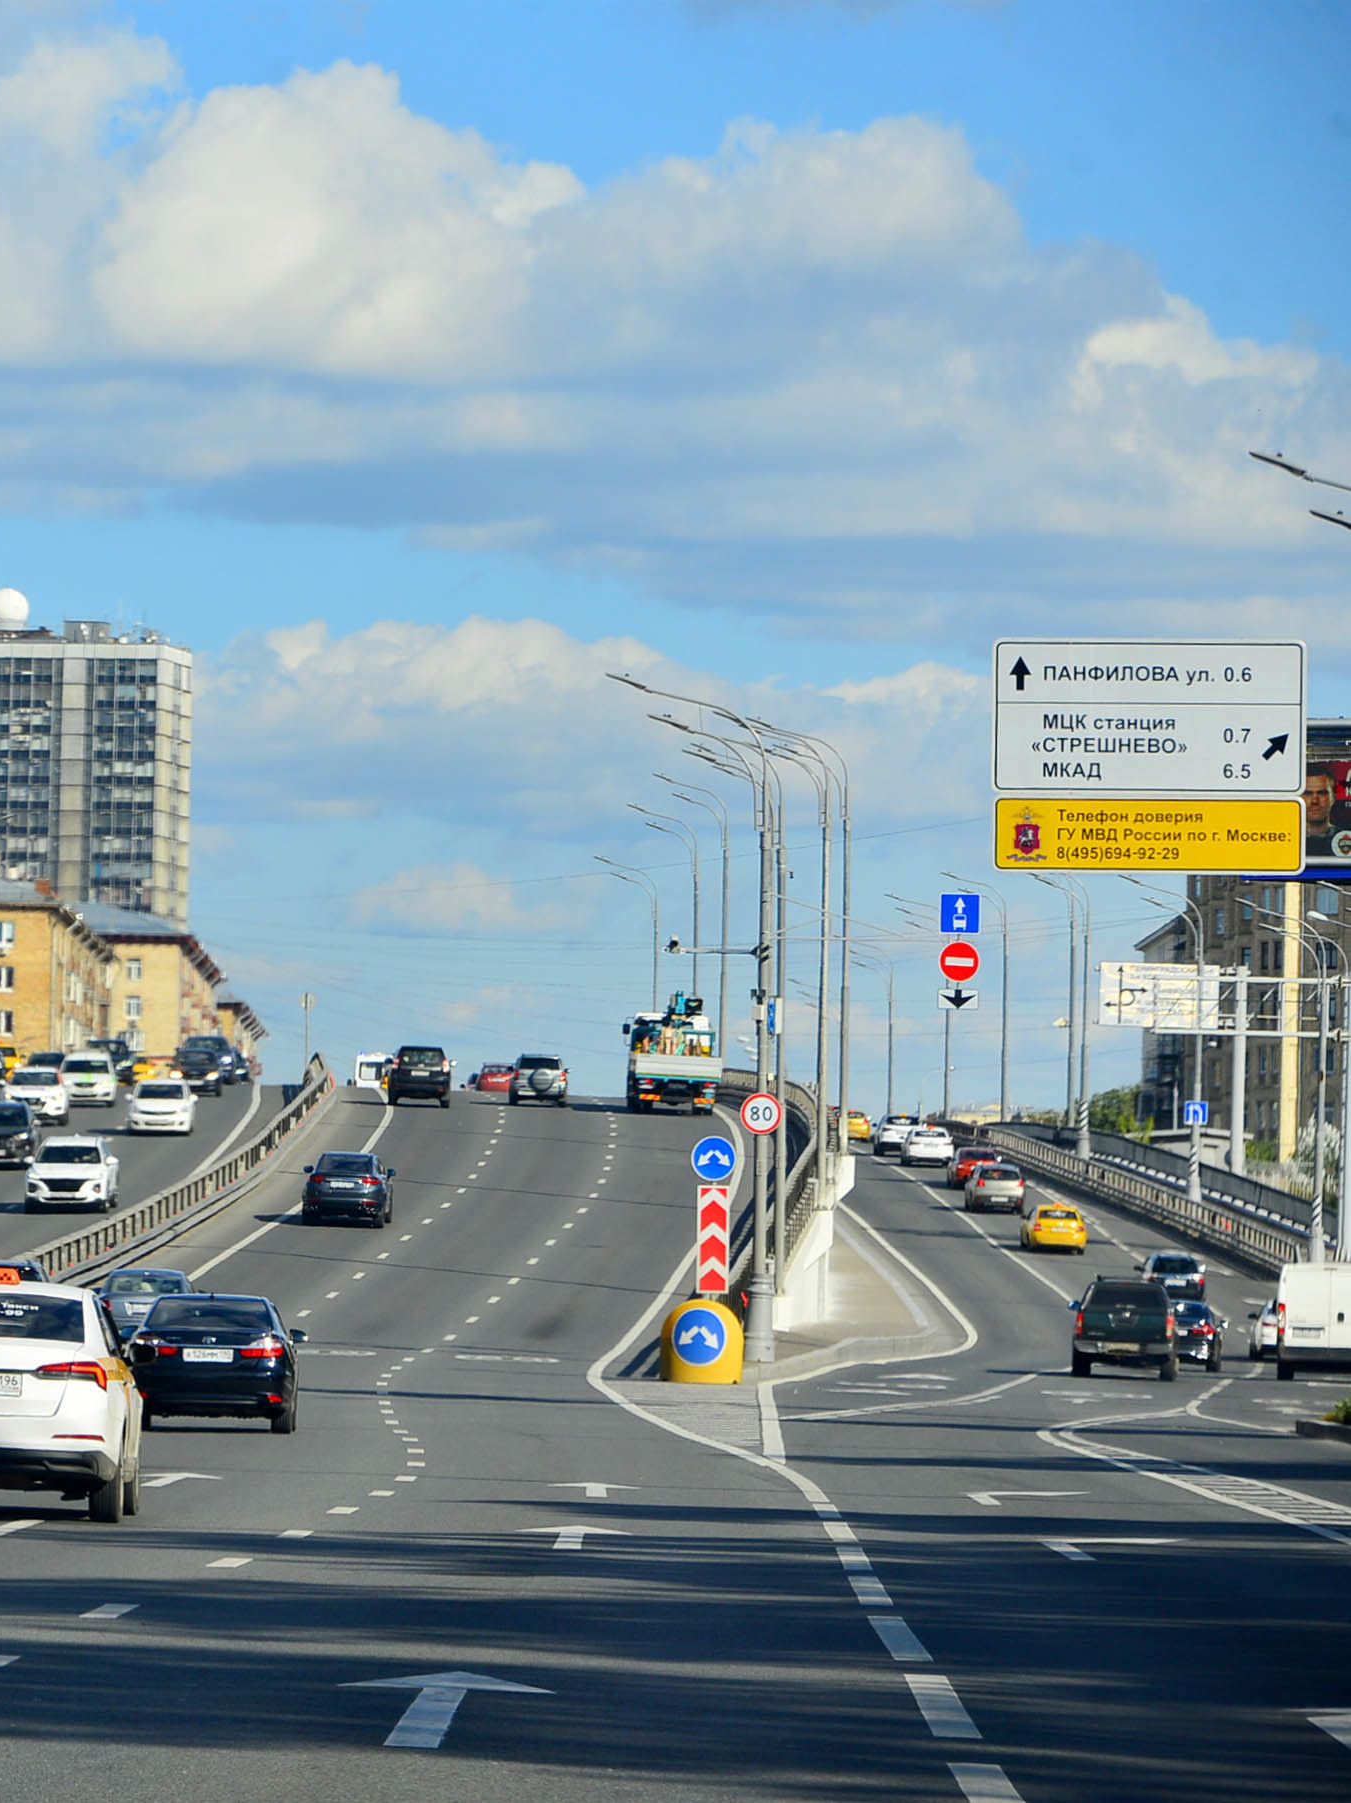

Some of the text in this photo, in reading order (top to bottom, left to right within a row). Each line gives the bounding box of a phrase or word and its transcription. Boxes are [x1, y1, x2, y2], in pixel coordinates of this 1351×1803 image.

[1043, 665, 1252, 686] ПАНФИЛОВА ул. 0.6
[1043, 713, 1176, 732] МЦК станция
[1223, 727, 1251, 744] 0.7
[1031, 737, 1188, 754] «СТРЕШНЕВО»
[1042, 762, 1251, 781] МКАД 6.5
[1057, 808, 1203, 825] Телефон доверия
[1057, 827, 1292, 843] ГУ МВД России по г. Москве:
[1056, 846, 1180, 862] 8(495)694-92-29
[750, 1106, 773, 1122] 80
